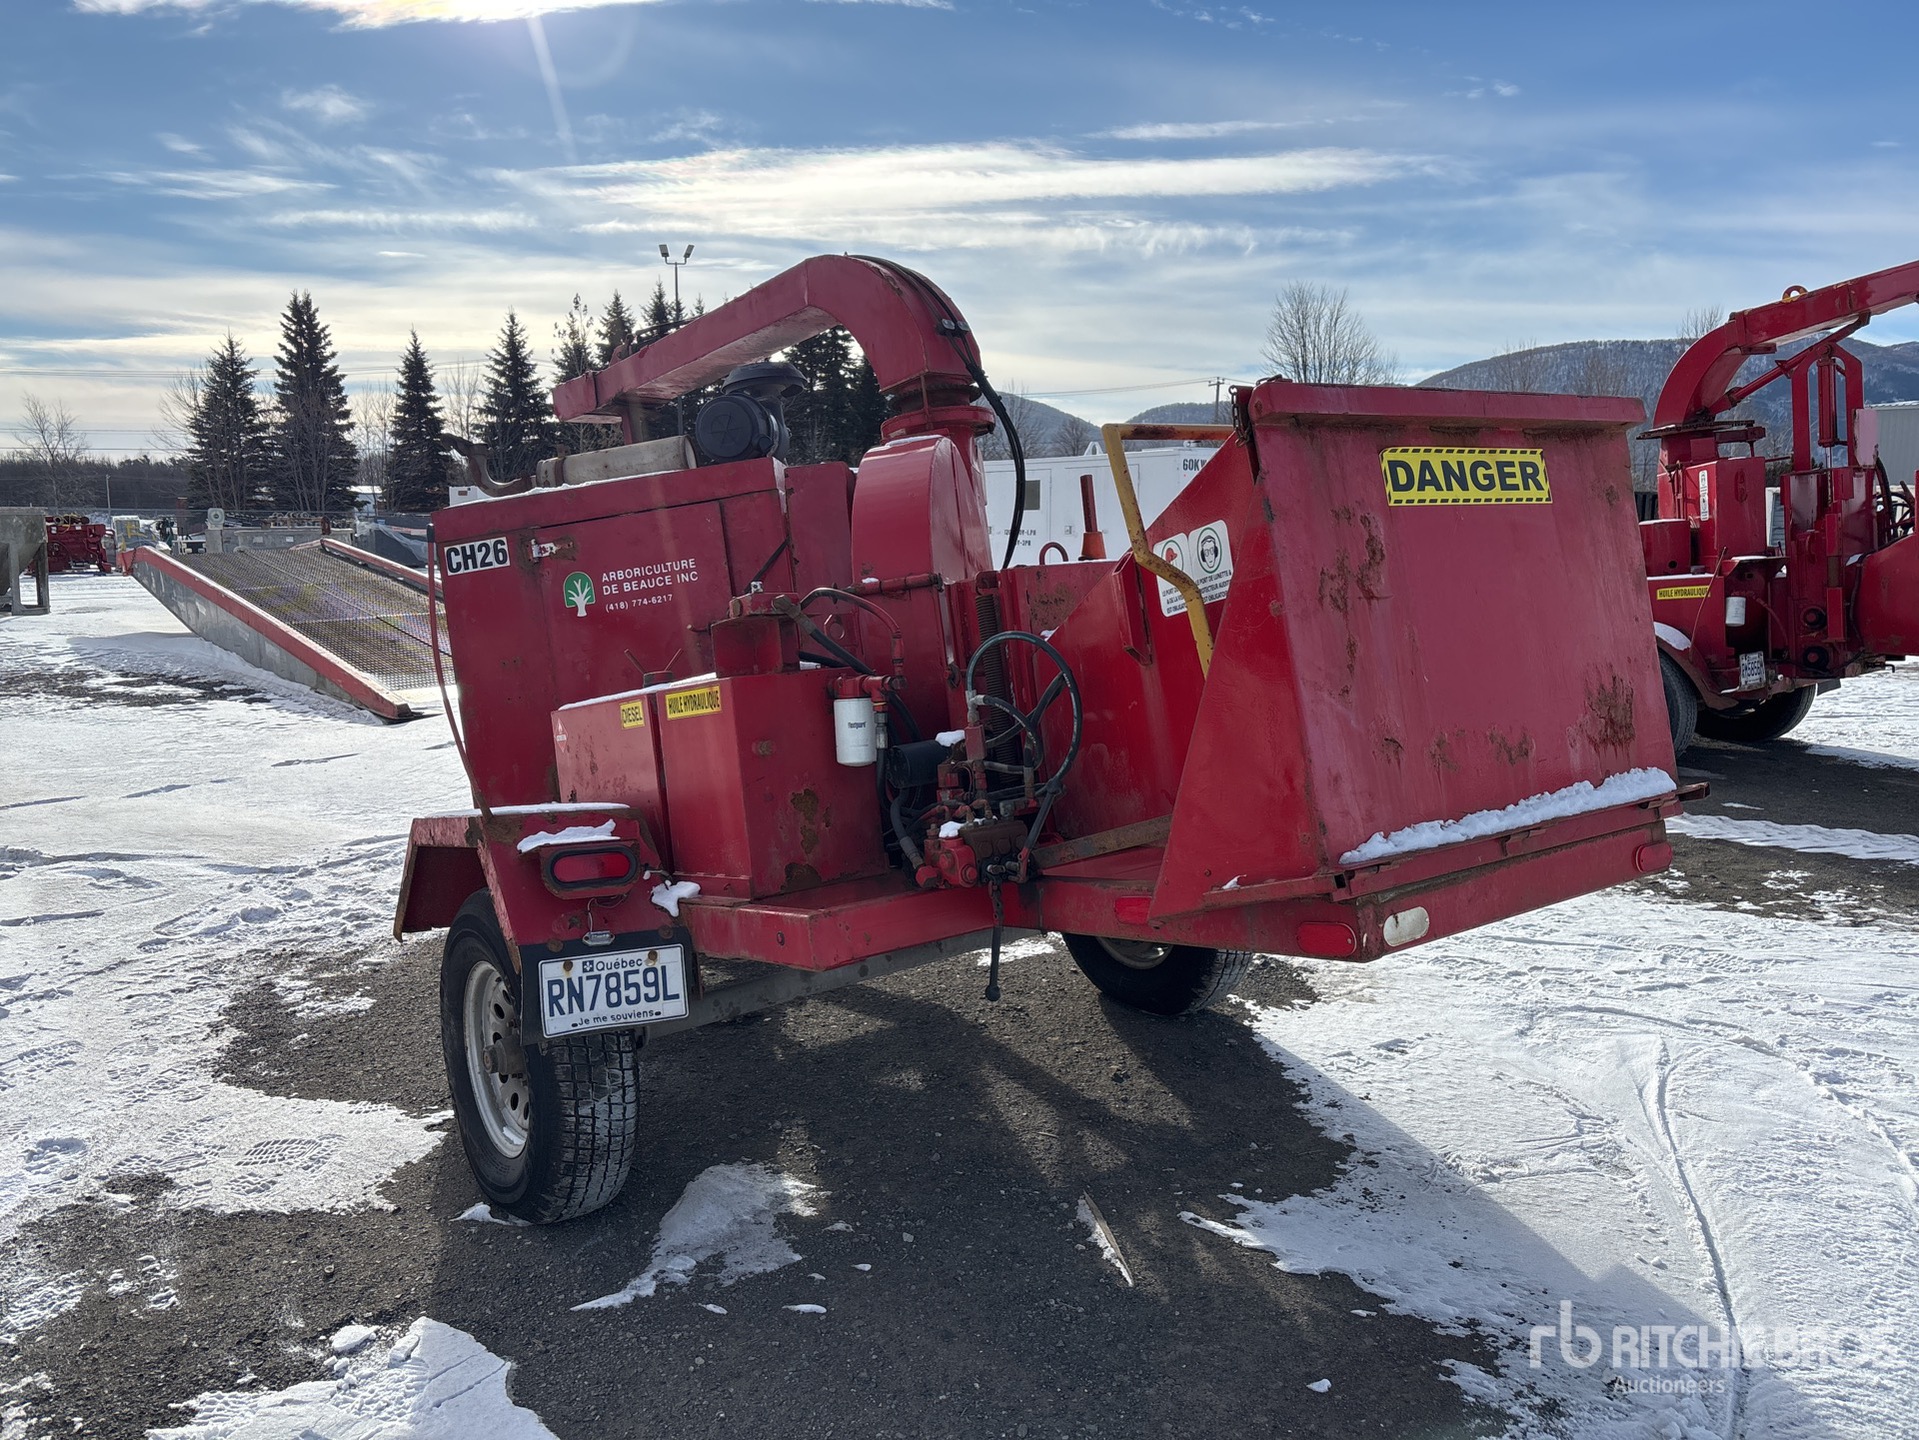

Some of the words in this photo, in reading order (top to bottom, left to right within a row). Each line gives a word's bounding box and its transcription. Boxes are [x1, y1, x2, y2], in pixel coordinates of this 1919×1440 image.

[1387, 459, 1545, 492] DANGER
[446, 539, 508, 573] CH26
[602, 558, 696, 583] ARBORICULTURE
[602, 584, 619, 596] DE
[623, 575, 673, 592] BEAUCE
[676, 571, 698, 584] INC
[1658, 589, 1673, 598] HUILE
[605, 601, 629, 613] (418)
[632, 593, 673, 607] 774-6217
[622, 706, 643, 723] DIESEL
[668, 696, 683, 715] HUILE
[683, 690, 720, 713] HYDRAULIQUE
[596, 957, 643, 972] Québec
[547, 965, 680, 1018] RN7859L
[578, 1016, 590, 1026] Je
[593, 1015, 608, 1024] me
[611, 1010, 654, 1021] souviens
